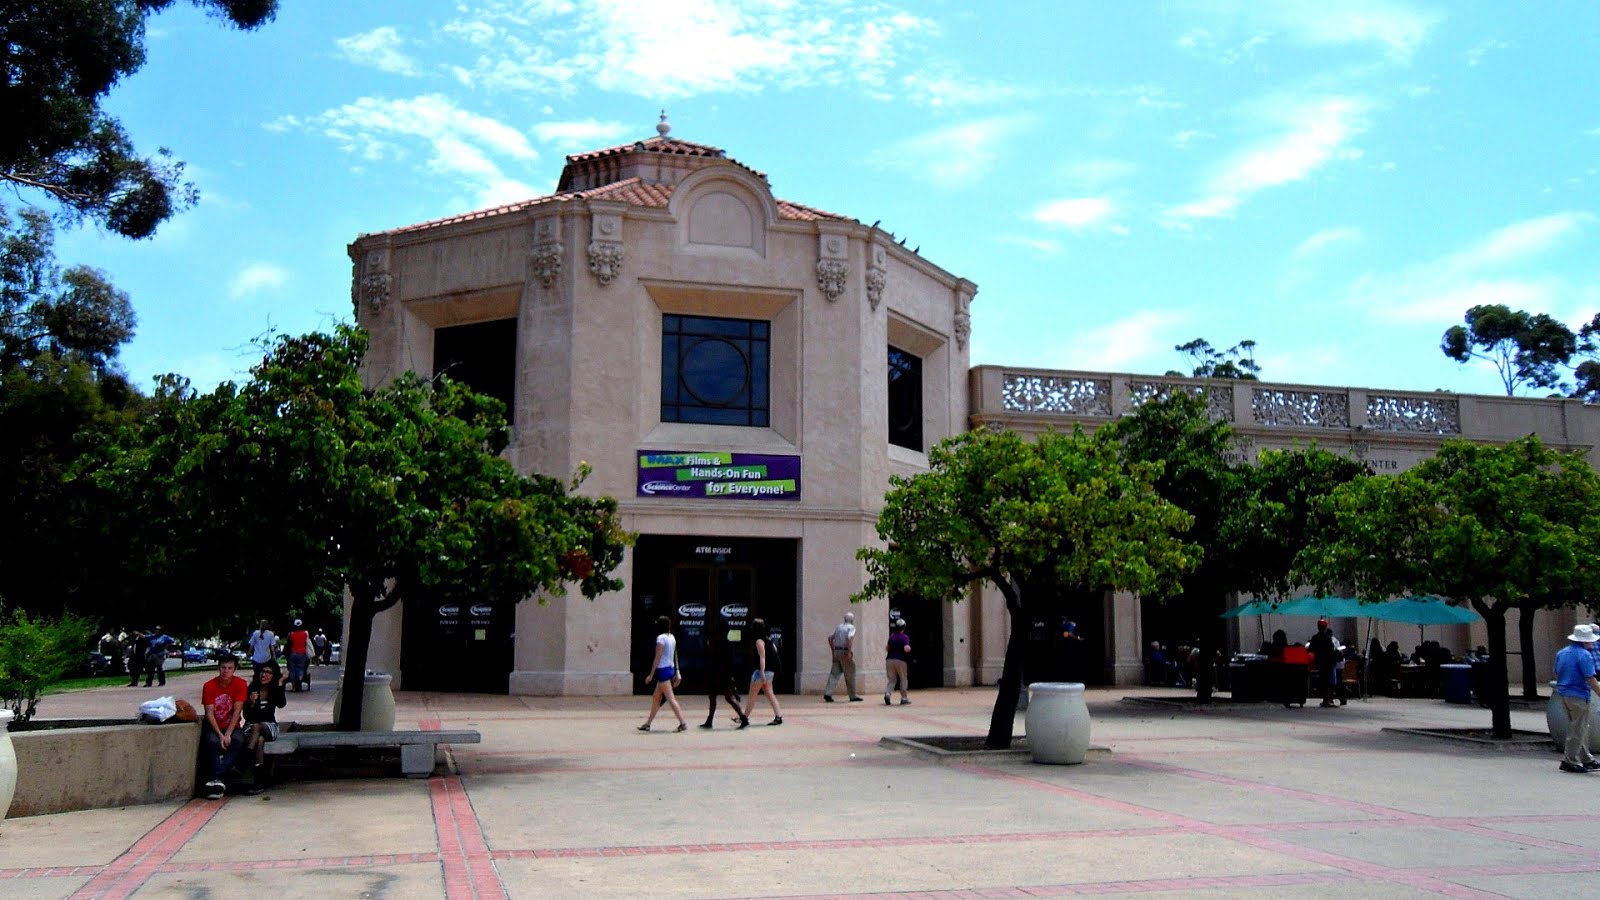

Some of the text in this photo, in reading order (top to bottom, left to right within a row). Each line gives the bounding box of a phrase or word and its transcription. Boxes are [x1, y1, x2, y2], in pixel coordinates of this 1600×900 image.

[646, 455, 721, 466] IMAX Films &
[691, 467, 761, 479] Hands-On Fun
[708, 482, 784, 496] for Everyone!
[695, 546, 712, 554] ATM
